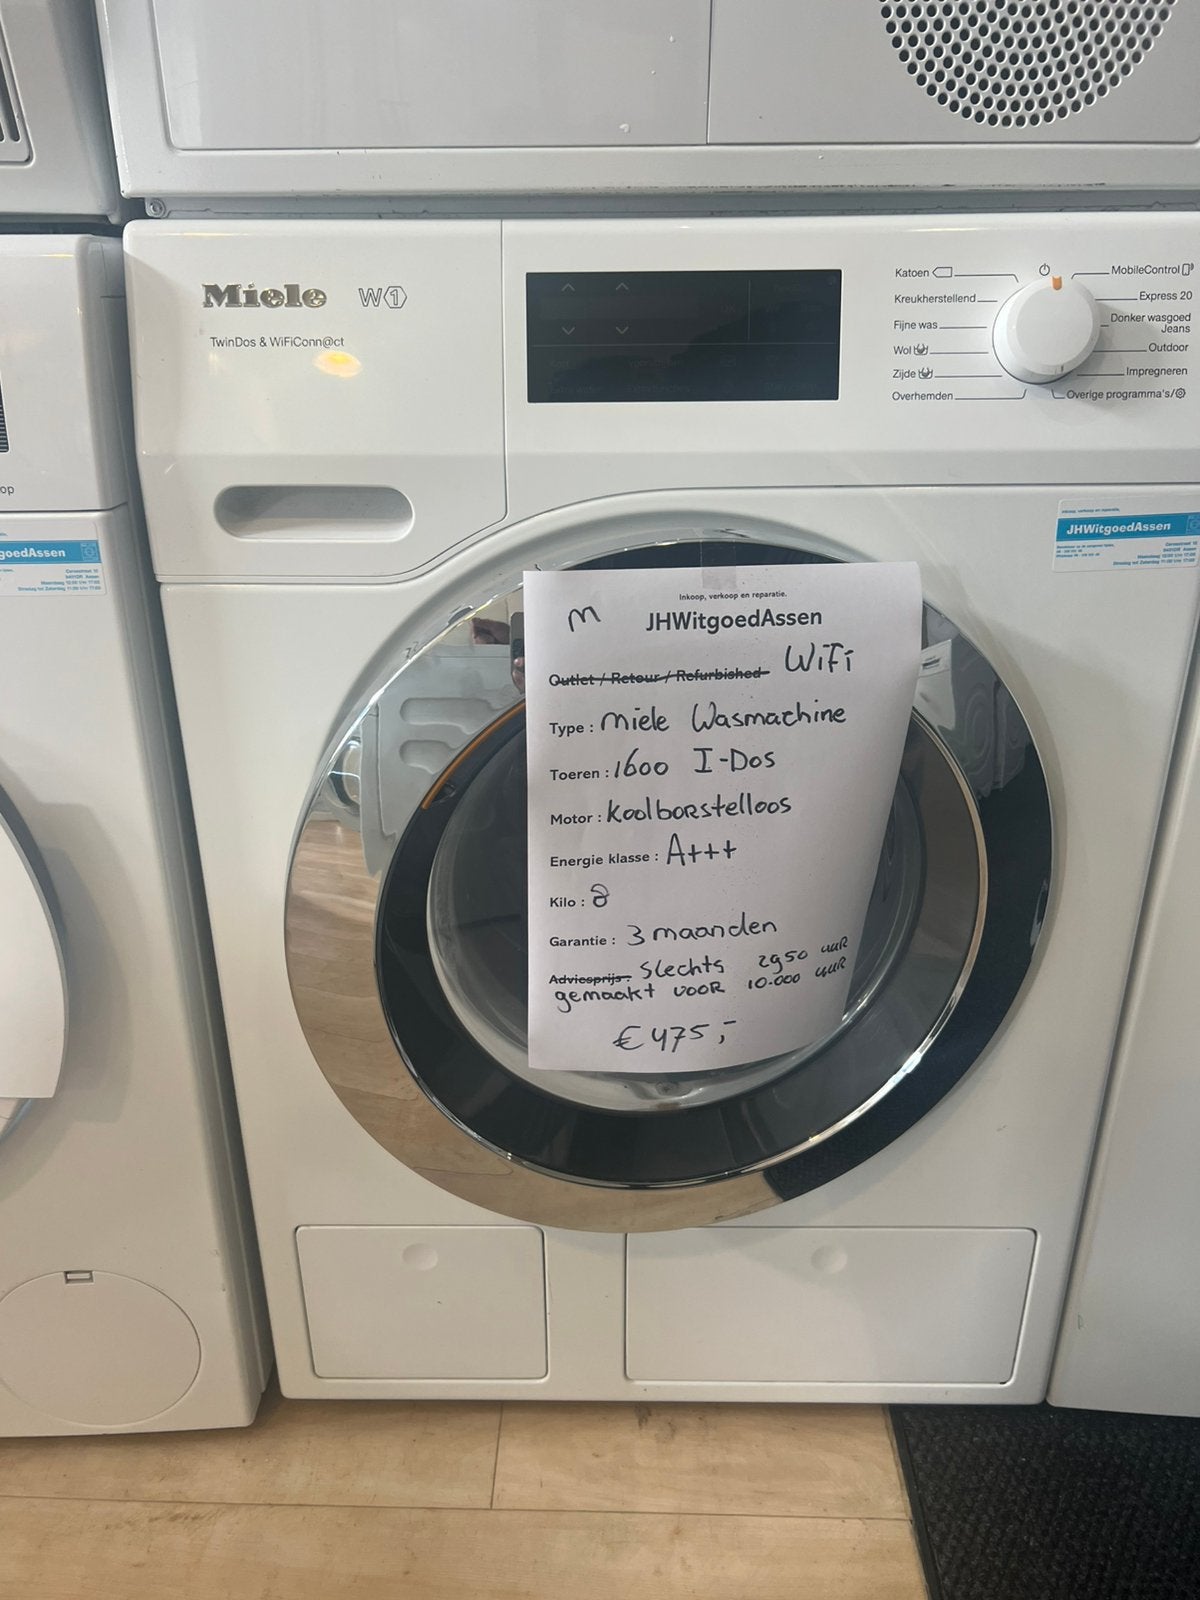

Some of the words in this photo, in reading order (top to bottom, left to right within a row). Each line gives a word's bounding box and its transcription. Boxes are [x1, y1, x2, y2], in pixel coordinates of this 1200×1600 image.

[895, 268, 930, 278] Katoen
[1111, 264, 1180, 276] MobileControl
[201, 283, 328, 309] Miele
[894, 293, 976, 304] Kreukherstellend
[1139, 291, 1178, 303] Express
[1179, 290, 1193, 301] 20
[1110, 312, 1146, 324] Donker
[1147, 313, 1191, 326] wasgoed
[893, 320, 916, 332] Fijne
[918, 321, 938, 330] was
[1161, 324, 1191, 334] Jeans
[210, 336, 256, 348] TwinDos
[259, 336, 267, 348] &
[269, 335, 345, 348] WiFiConn@ct
[1148, 342, 1189, 353] Outdoor
[893, 345, 912, 355] Wol
[892, 369, 916, 380] Zijde
[1126, 366, 1188, 378] Impregneren
[892, 391, 953, 401] Overhemden
[1066, 389, 1103, 401] Overige
[1066, 521, 1171, 536] JHWitgoedAssen
[679, 593, 707, 601] Inkoop,
[708, 592, 739, 600] verkoop
[751, 590, 788, 599] reparatie.
[645, 607, 823, 635] JHWitgoedAssen
[549, 673, 595, 687] Outlet
[611, 671, 661, 686] Retour
[676, 666, 763, 683] Refurbished
[549, 721, 585, 736] Type
[549, 769, 600, 782] Toeren
[613, 748, 669, 779] 1600
[550, 812, 593, 826] Motor
[550, 855, 604, 869] Energie
[608, 851, 650, 865] klasse
[666, 833, 738, 867] A+++
[549, 896, 577, 908] Kilo
[549, 936, 607, 947] Garantie
[626, 924, 646, 947] 3
[652, 911, 778, 942] maanden
[554, 982, 656, 1014] gemaakt
[747, 973, 801, 990] 10.000
